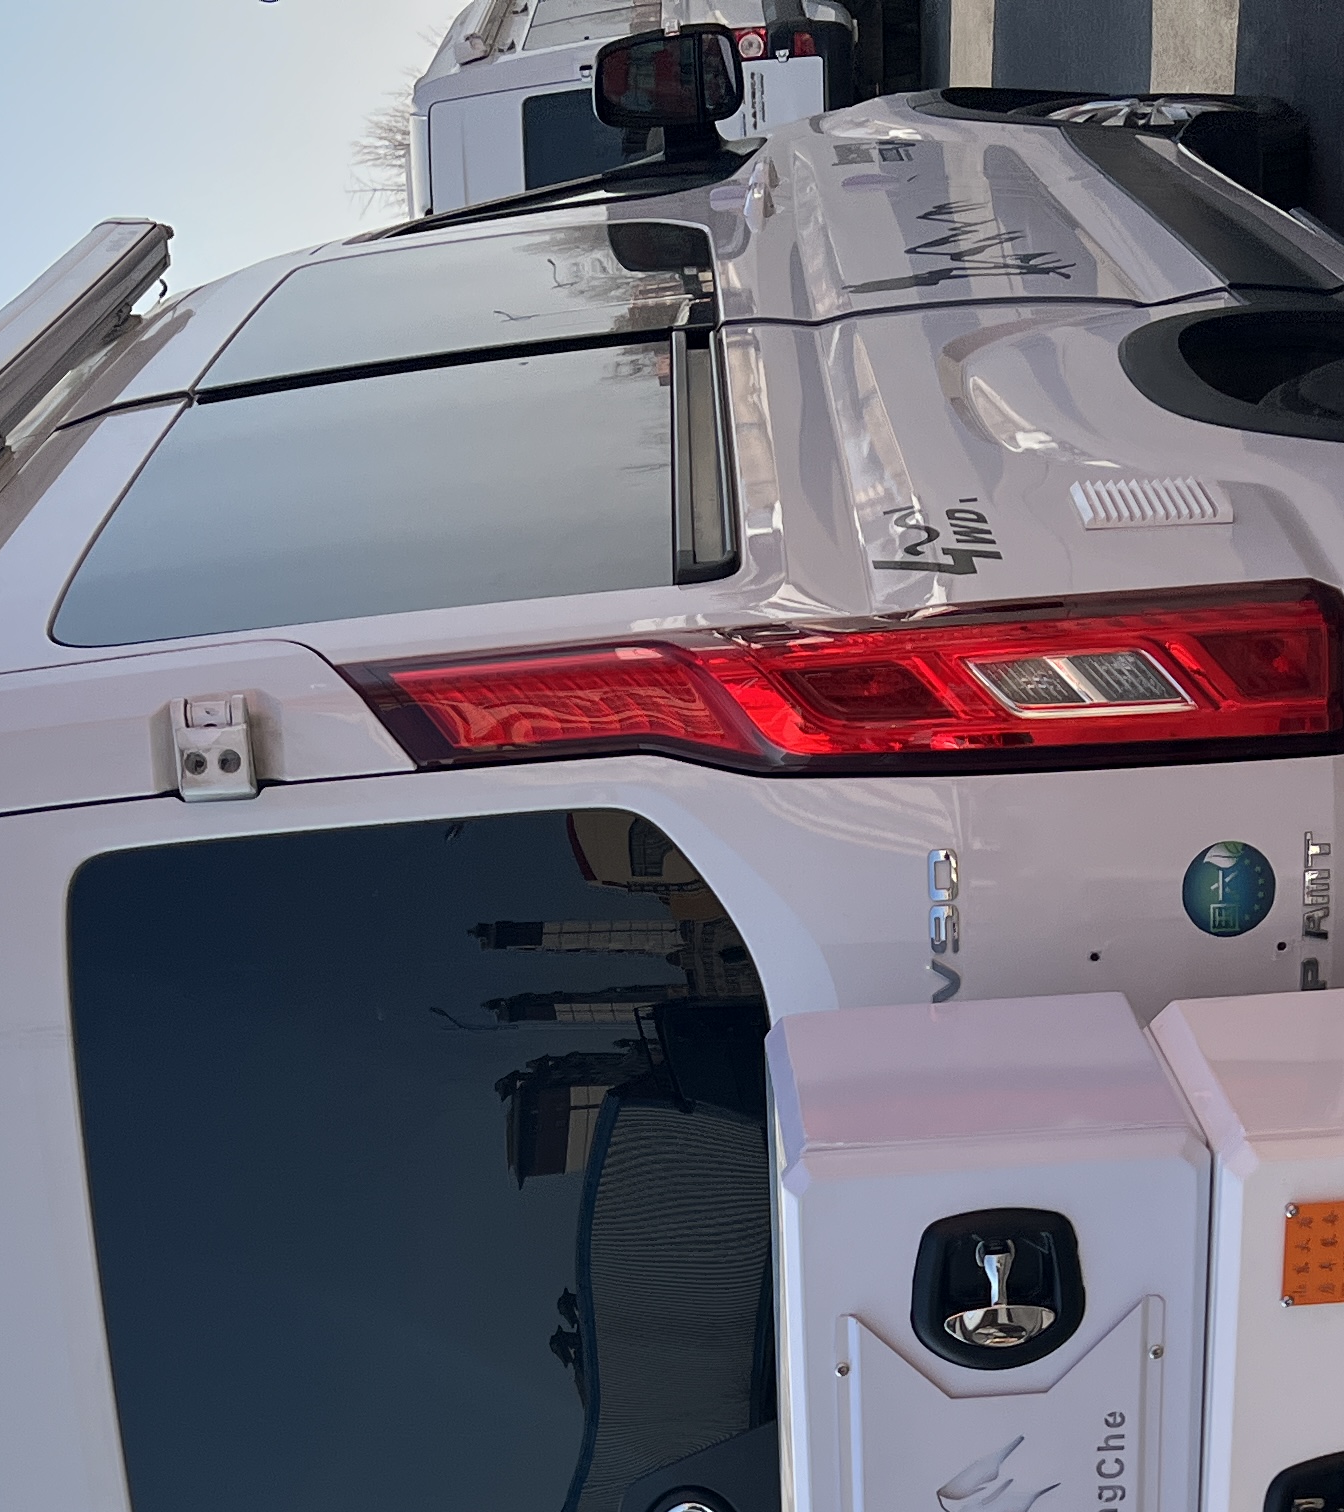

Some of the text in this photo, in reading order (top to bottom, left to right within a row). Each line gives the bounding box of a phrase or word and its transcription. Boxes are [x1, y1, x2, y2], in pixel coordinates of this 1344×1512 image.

[927, 849, 961, 1003] V90
[1209, 869, 1241, 932] 国六
[1301, 831, 1331, 940] AMT
